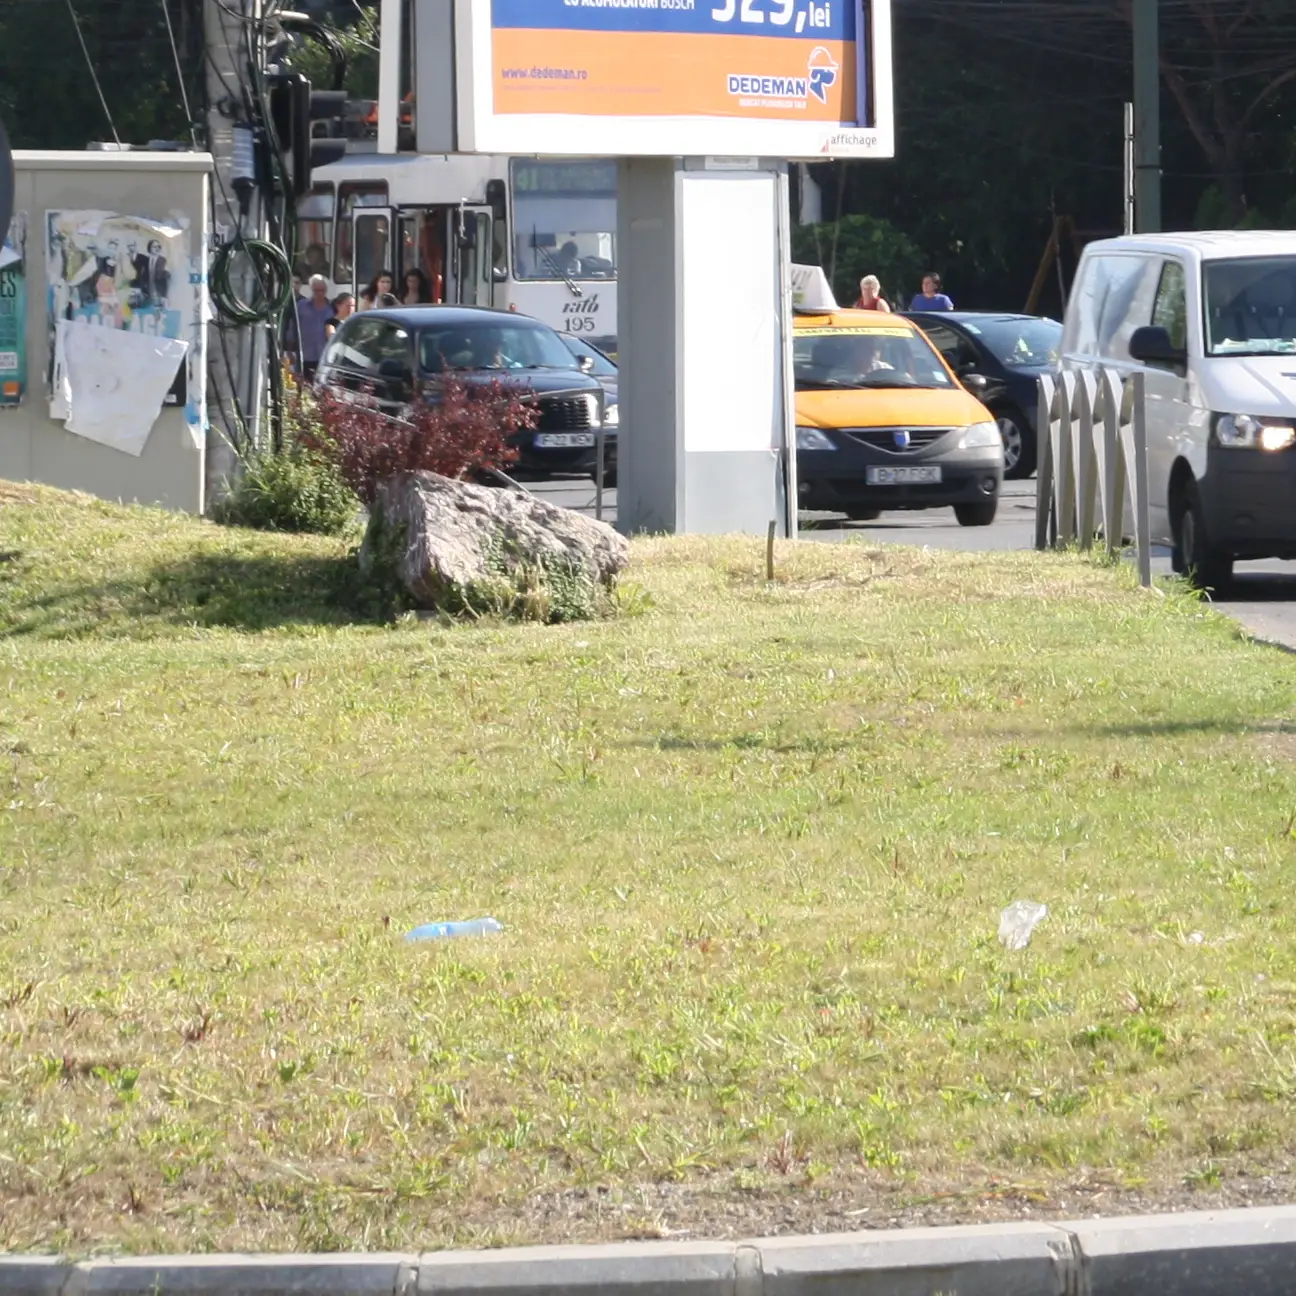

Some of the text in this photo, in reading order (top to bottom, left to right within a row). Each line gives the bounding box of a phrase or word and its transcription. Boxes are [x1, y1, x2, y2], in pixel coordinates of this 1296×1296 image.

[809, 1, 831, 28] lei
[501, 65, 588, 80] www.dedeman.ro
[728, 76, 807, 96] DEDEMAN
[830, 134, 877, 148] affichage
[564, 316, 596, 332] 195
